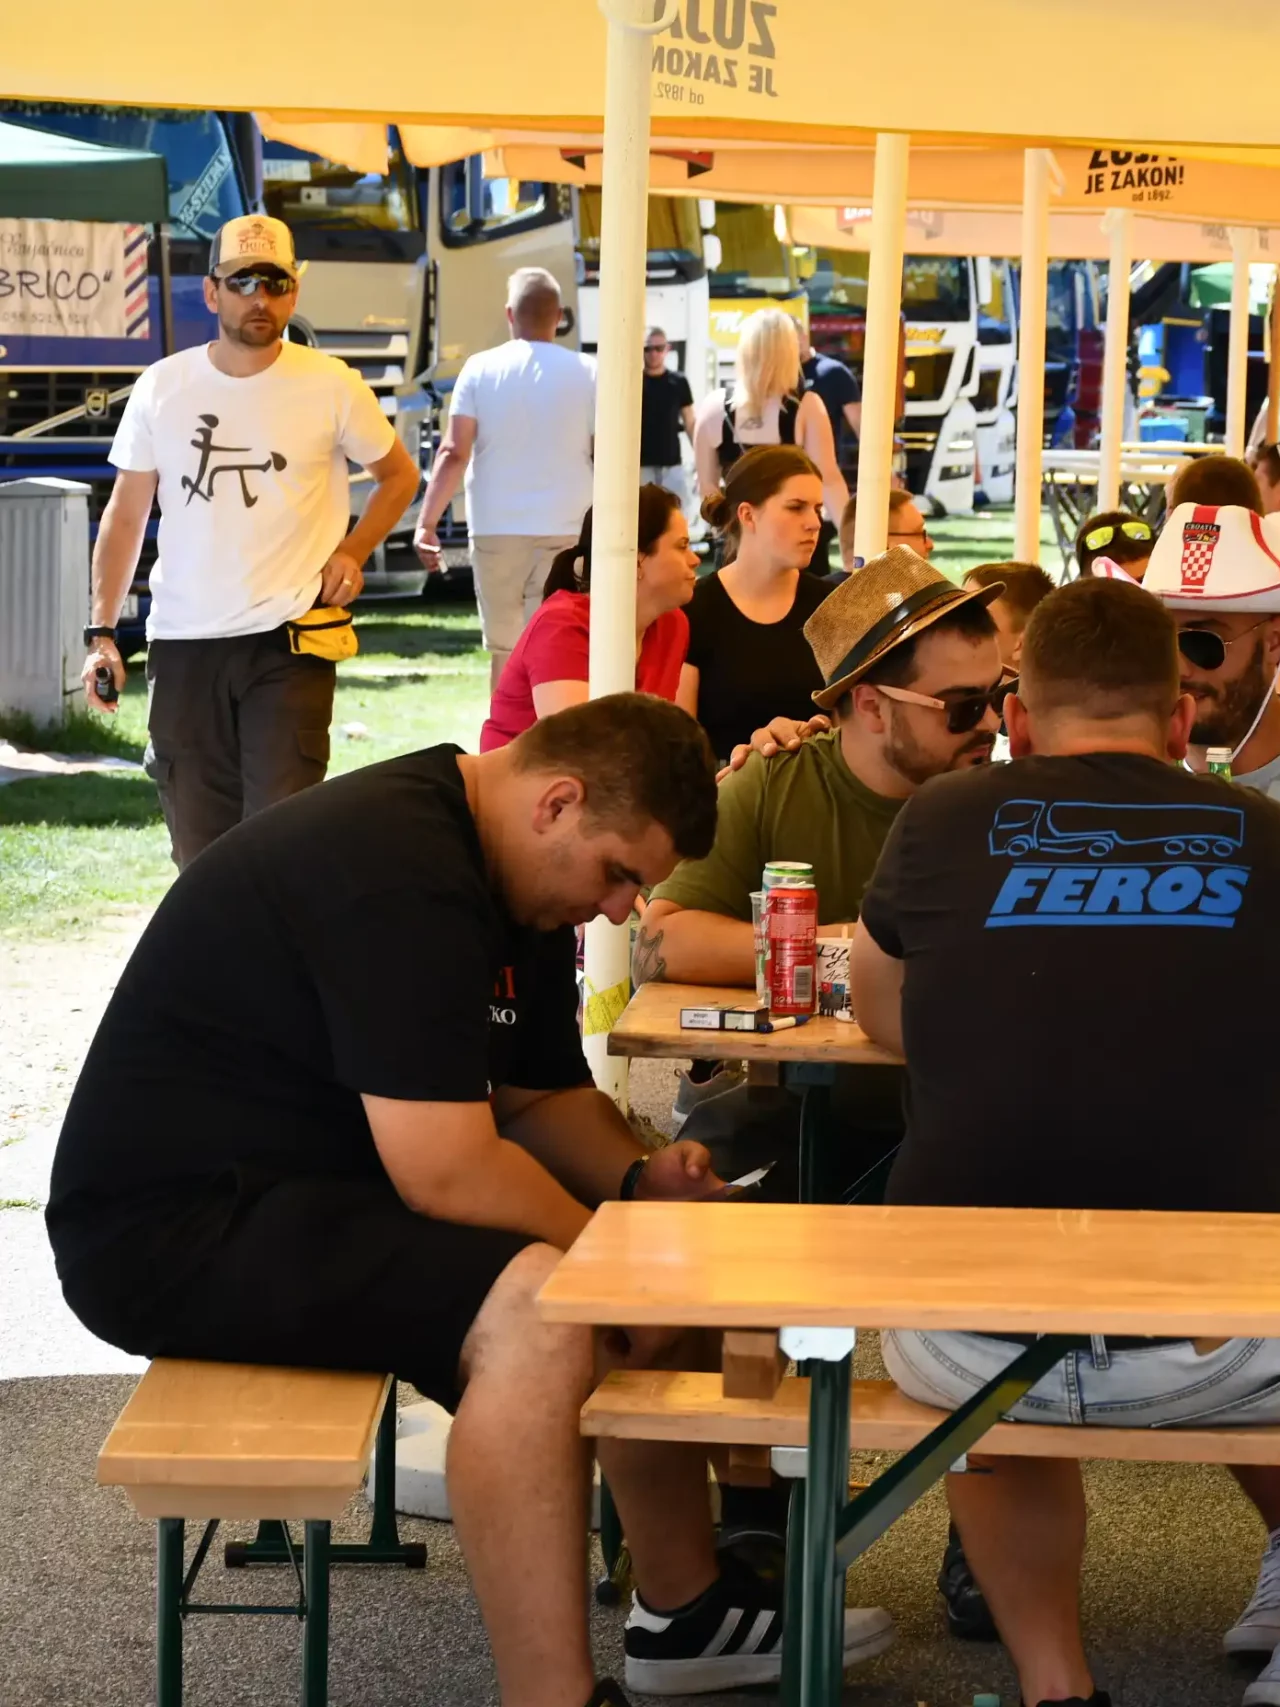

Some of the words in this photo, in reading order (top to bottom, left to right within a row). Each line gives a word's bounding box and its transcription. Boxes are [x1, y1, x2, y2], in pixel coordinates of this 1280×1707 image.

[1084, 172, 1105, 195] JE
[1110, 165, 1184, 191] ZAKON!
[1185, 523, 1217, 531] CROATIA
[990, 866, 1250, 914] FEROS
